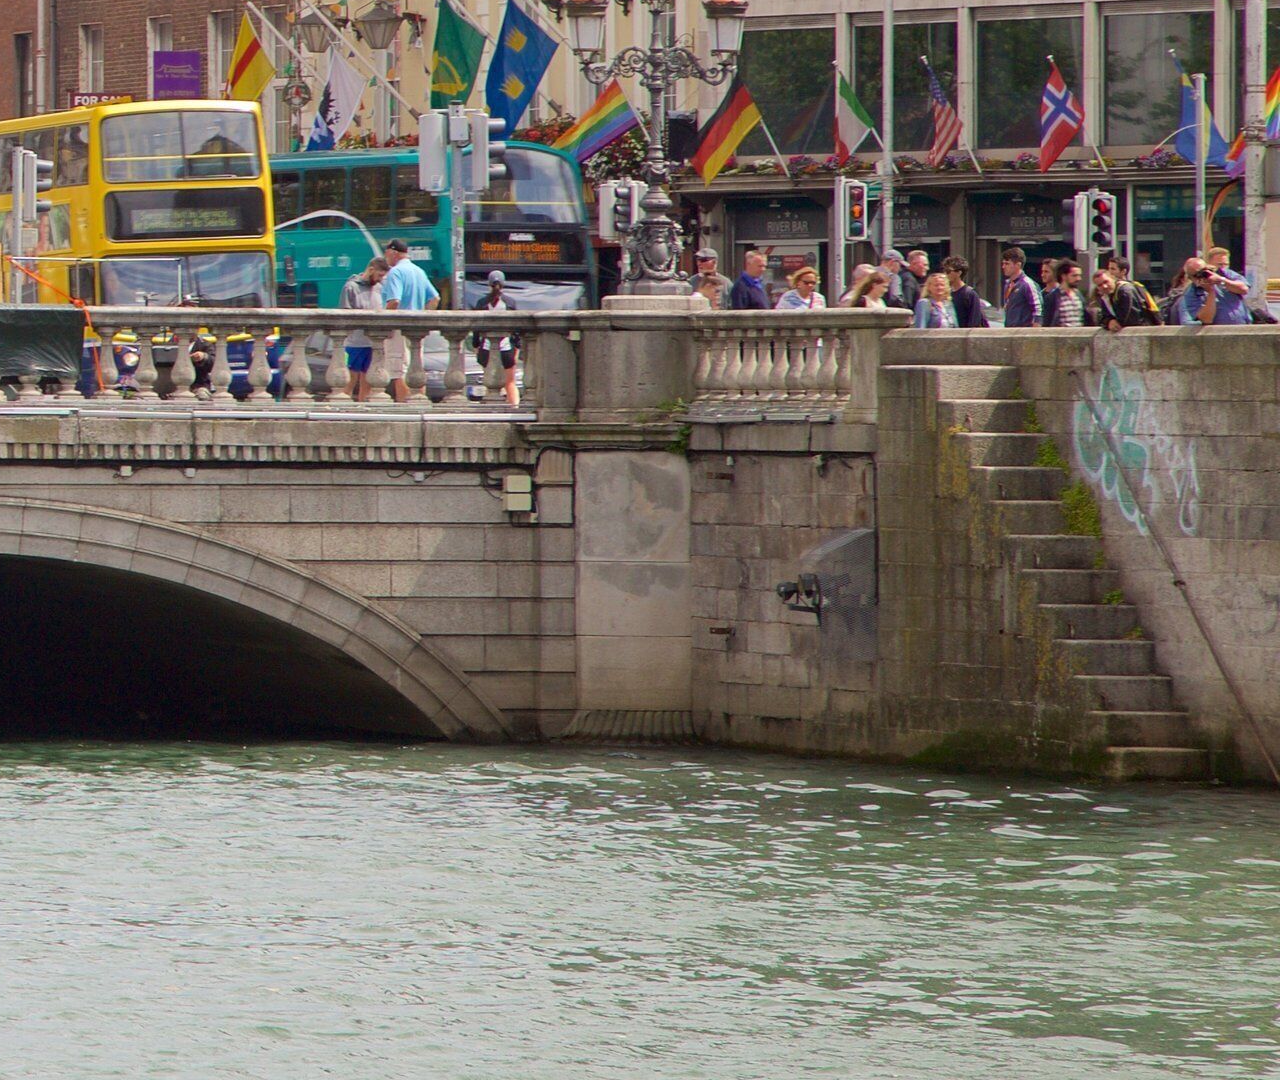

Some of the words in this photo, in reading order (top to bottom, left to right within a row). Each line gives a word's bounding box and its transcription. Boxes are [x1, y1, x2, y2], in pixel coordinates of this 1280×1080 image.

[74, 95, 99, 106] FOR
[767, 221, 790, 233] RIVER
[791, 221, 809, 233] BAR
[911, 218, 928, 230] BAR
